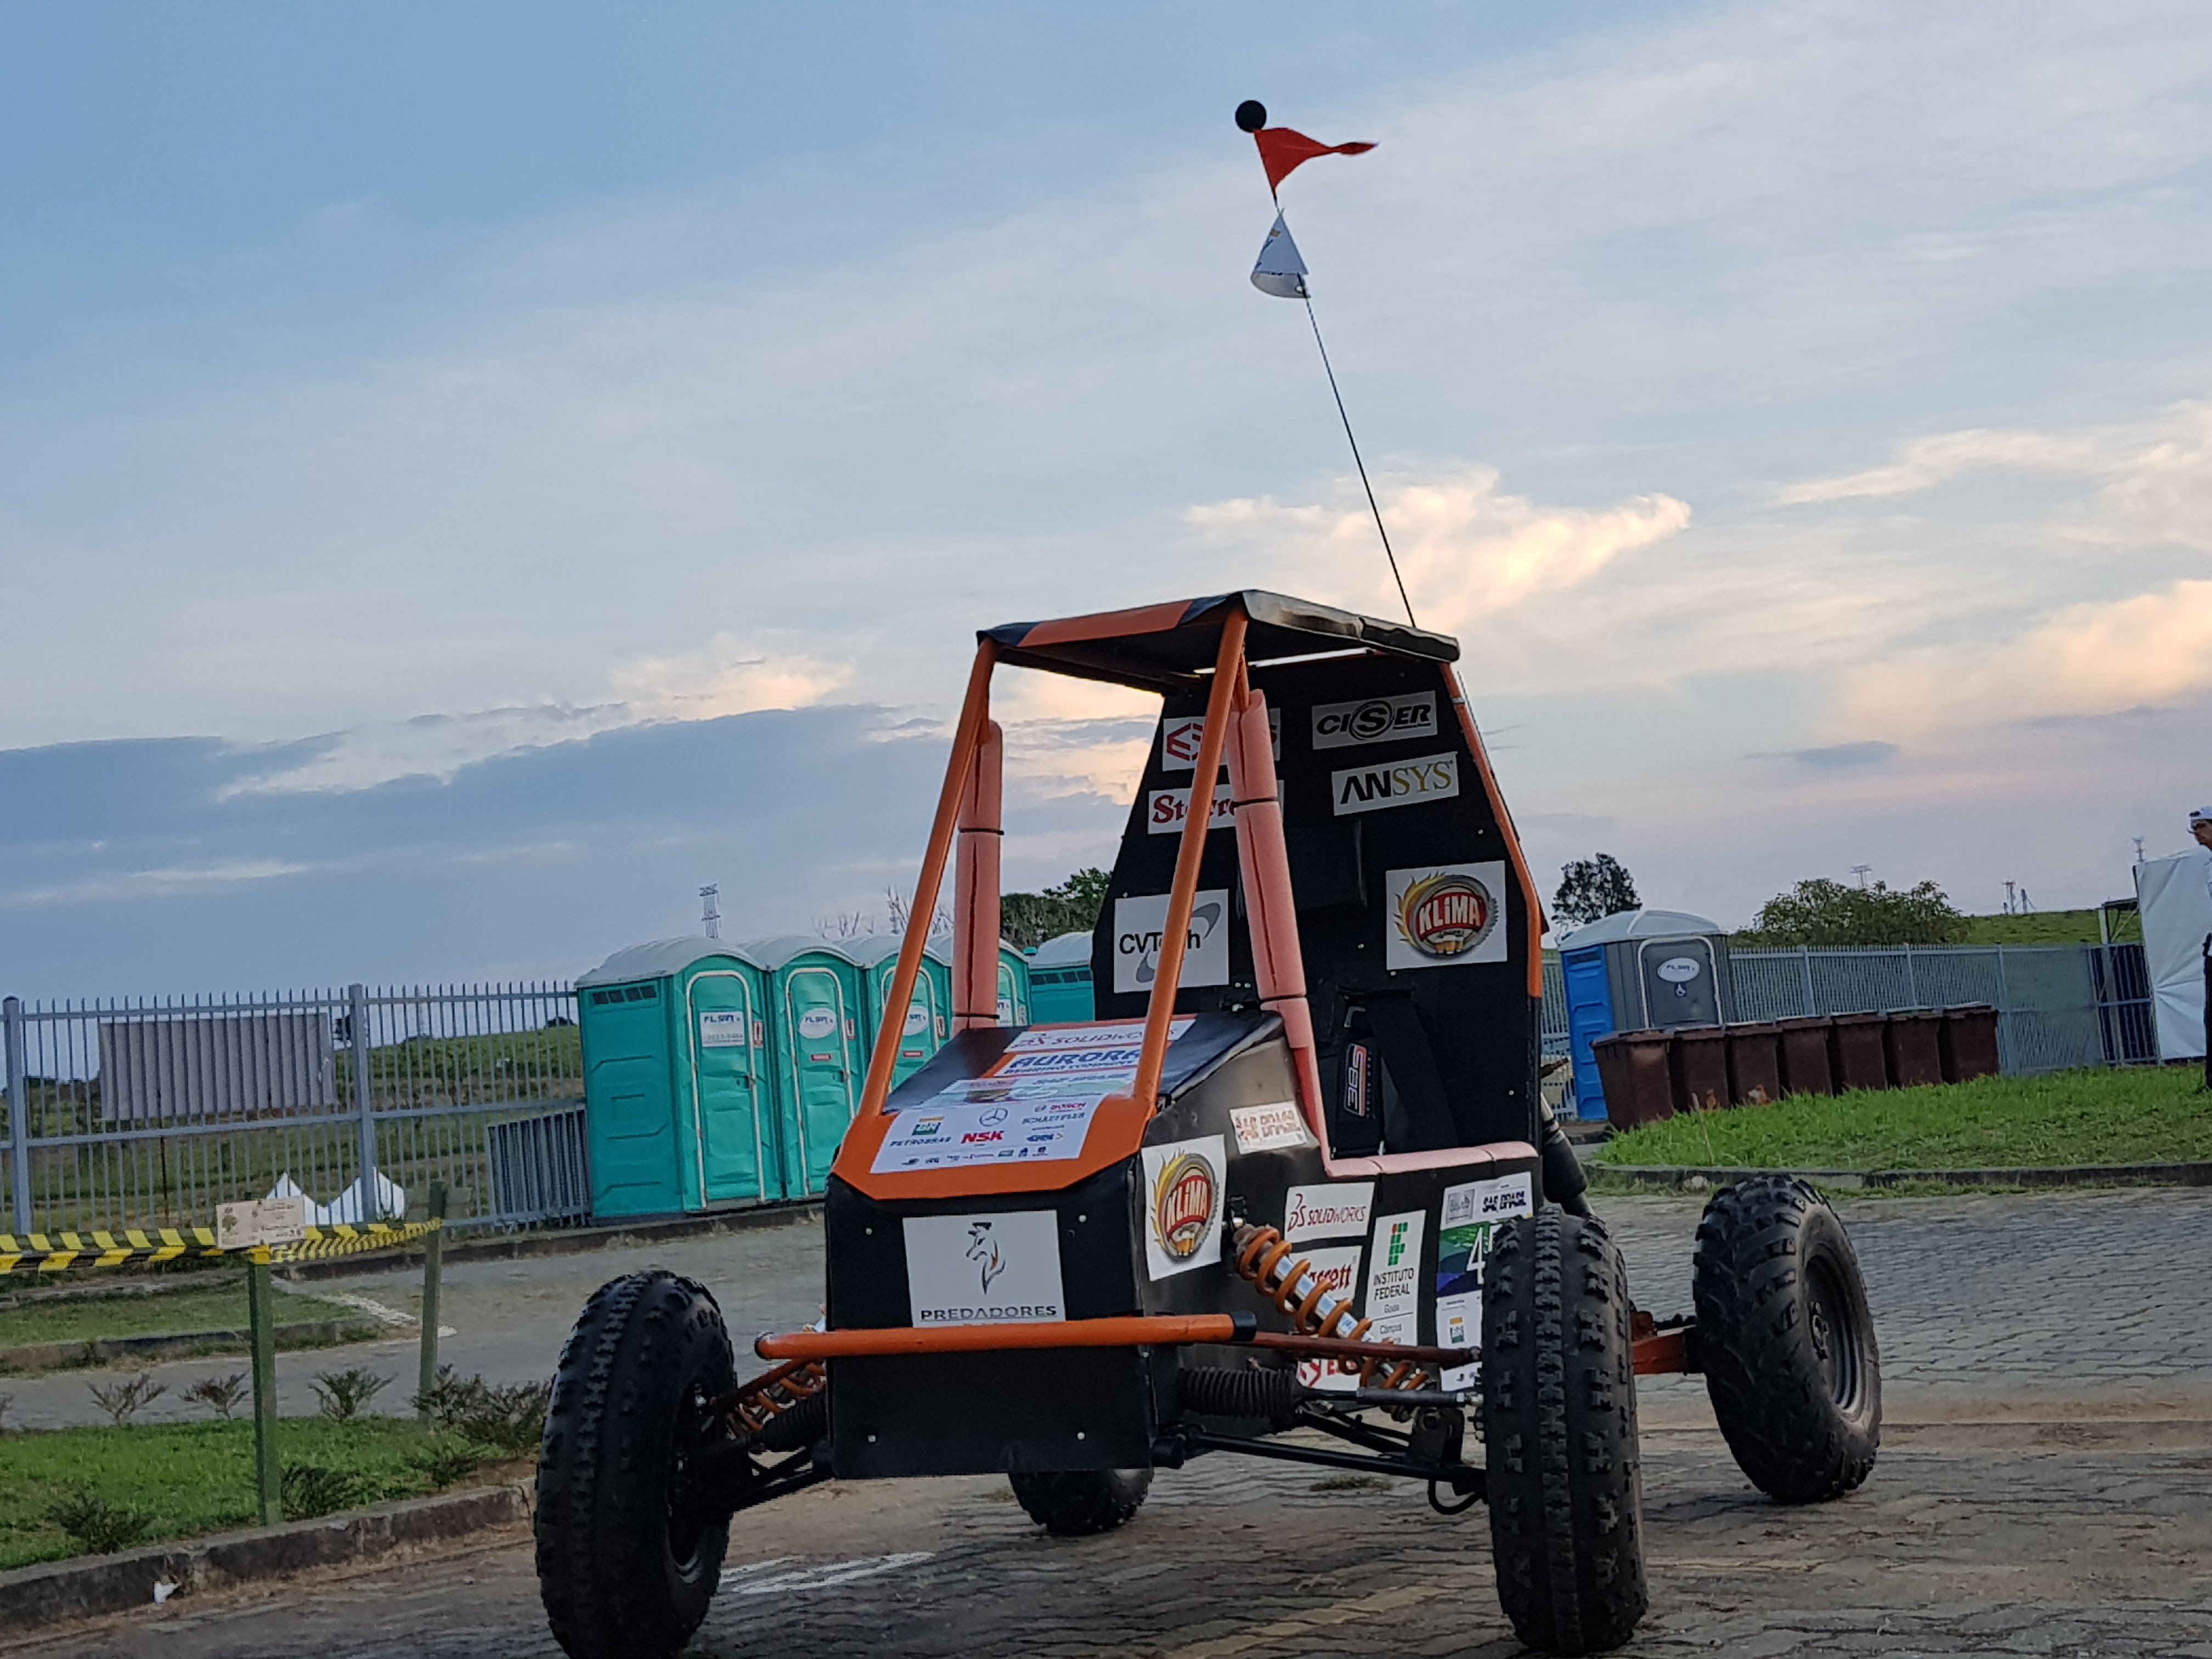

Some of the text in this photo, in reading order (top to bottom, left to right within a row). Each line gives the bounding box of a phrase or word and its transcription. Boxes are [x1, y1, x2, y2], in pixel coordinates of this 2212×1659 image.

[1317, 702, 1431, 738] CISER
[1340, 761, 1451, 805] ANSYS
[961, 1131, 1005, 1144] NSK
[1373, 1268, 1414, 1286] INSTITUTO
[1374, 1284, 1410, 1301] FEDERAL
[921, 1305, 1057, 1321] PREDADORES
